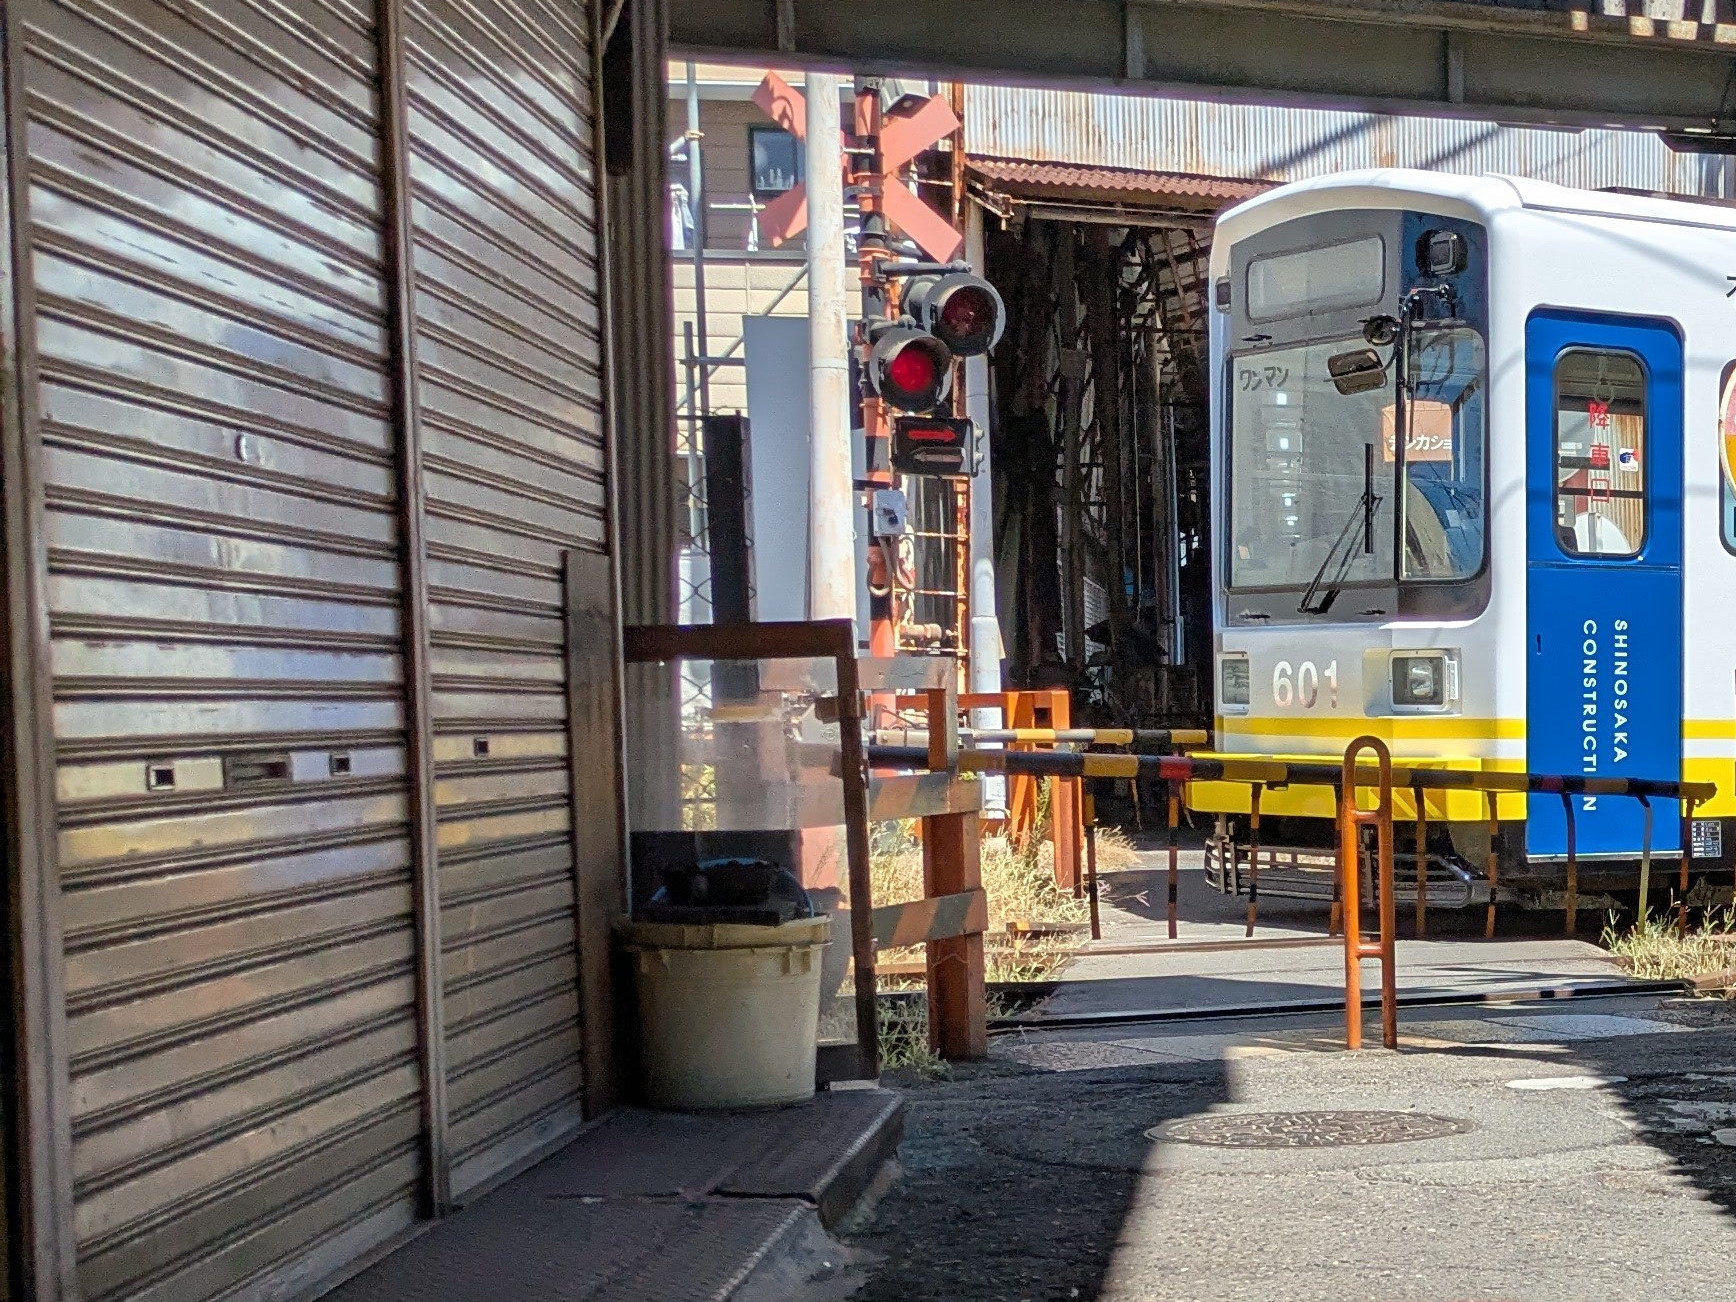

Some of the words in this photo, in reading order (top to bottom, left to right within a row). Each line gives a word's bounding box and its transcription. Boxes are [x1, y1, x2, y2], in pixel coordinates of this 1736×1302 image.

[1240, 366, 1289, 391] ワンマン
[1587, 400, 1610, 503] 降車口
[1272, 659, 1338, 710] 601
[1582, 619, 1598, 811] CONSTRUCTIN
[1614, 619, 1628, 763] SHINOSAKA
